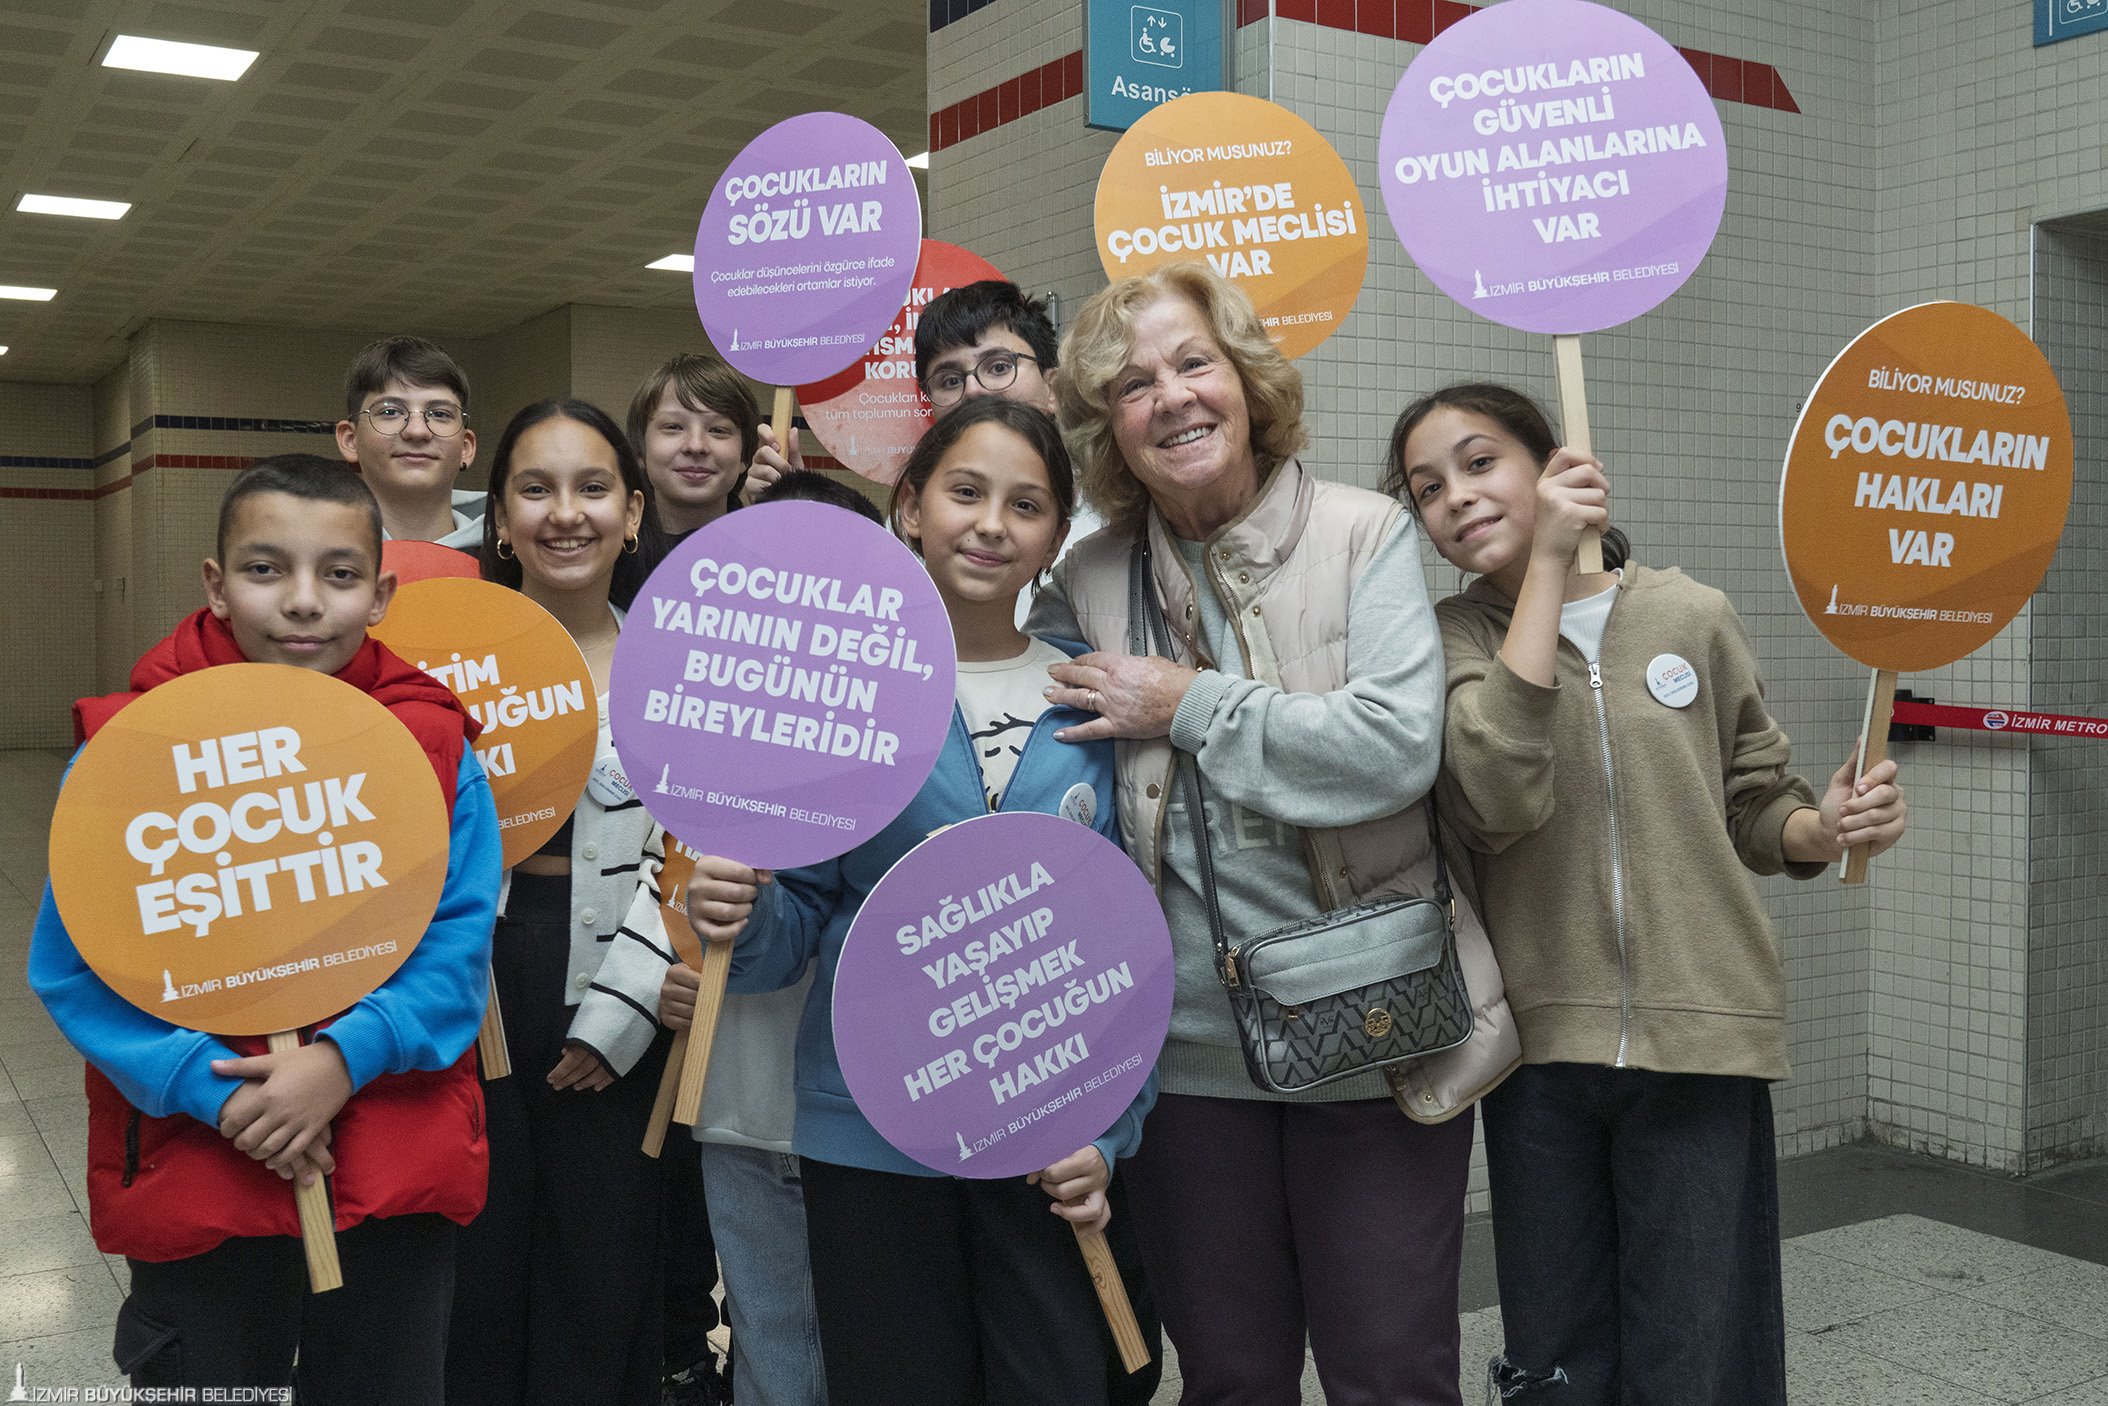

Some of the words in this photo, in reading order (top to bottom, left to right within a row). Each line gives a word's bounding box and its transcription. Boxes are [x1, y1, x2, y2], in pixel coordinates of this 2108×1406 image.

[1429, 52, 1645, 109] ÇOCUKLARIN
[1473, 86, 1615, 136] GÜVENLİ
[1144, 147, 1203, 166] BİLİYOR
[1207, 140, 1292, 162] MUSUNUZ?
[1395, 148, 1489, 185] OYUN
[1497, 122, 1706, 173] ALANLARINA
[725, 160, 887, 206] ÇOCUKLARIN
[1159, 180, 1295, 219] İZMİR'DE
[1482, 169, 1630, 212] İHTİYACI
[728, 199, 811, 246] SÖZÜ
[817, 201, 884, 236] VAR
[1107, 221, 1227, 264] ÇOCUK
[1232, 200, 1356, 245] MECLİSİ
[1532, 212, 1601, 244] VAR
[711, 270, 754, 283] Çocuklar
[757, 262, 822, 279] düşüncelerini
[824, 259, 865, 274] özgürce
[867, 256, 895, 268] ifade
[727, 282, 795, 298] edebilecekleri
[797, 278, 841, 292] ortamlar
[843, 275, 876, 289] istiyor.
[1206, 249, 1273, 279] VAR
[1489, 280, 1525, 297] İZMİR
[1528, 271, 1610, 293] BÜYÜKŞEHİR
[1613, 262, 1680, 282] BELEDİYESİ
[1868, 365, 1932, 395] BİLİYOR
[1934, 376, 2026, 405] MUSUNUZ?
[1824, 413, 2050, 471] ÇOCUKLARIN
[1853, 471, 2004, 519] HAKLARI
[1888, 528, 1955, 568] VAR
[690, 558, 904, 622] ÇOCUKLAR
[1839, 602, 1868, 616] İZMİR
[1870, 604, 1937, 622] BÜYÜKŞEHİR
[1939, 608, 1993, 625] BELEDİYESİ
[652, 596, 802, 652] YARININ
[809, 623, 934, 682] DEĞİL,
[683, 649, 879, 714] BUGÜNÜN
[643, 684, 899, 767] BİREYLERİDİR
[2011, 714, 2051, 730] İZMİR
[2054, 720, 2108, 735] METRO
[171, 726, 308, 795] HER
[124, 772, 377, 877] ÇOCUK
[671, 782, 704, 802] İZMİR
[706, 790, 787, 819] BÜYÜKŞEHİR
[789, 807, 856, 832] BELEDİYESİ
[135, 831, 390, 938] EŞİTTİR
[896, 861, 1056, 956] SAĞLIKLA
[181, 978, 222, 998] İZMİR
[225, 957, 320, 989] BÜYÜKŞEHİR
[323, 939, 398, 968] BELEDİYESİ
[922, 906, 1055, 991] YAŞAYIP
[927, 939, 1085, 1038] GELİŞMEK
[903, 1049, 972, 1102] HER
[972, 961, 1135, 1070] ÇOCUĞUN
[988, 1032, 1090, 1105] HAKKI
[973, 1127, 1007, 1153] İZMİR
[1008, 1087, 1083, 1135] BÜYÜKŞEHİR
[1084, 1053, 1143, 1094] BELEDİYESİ
